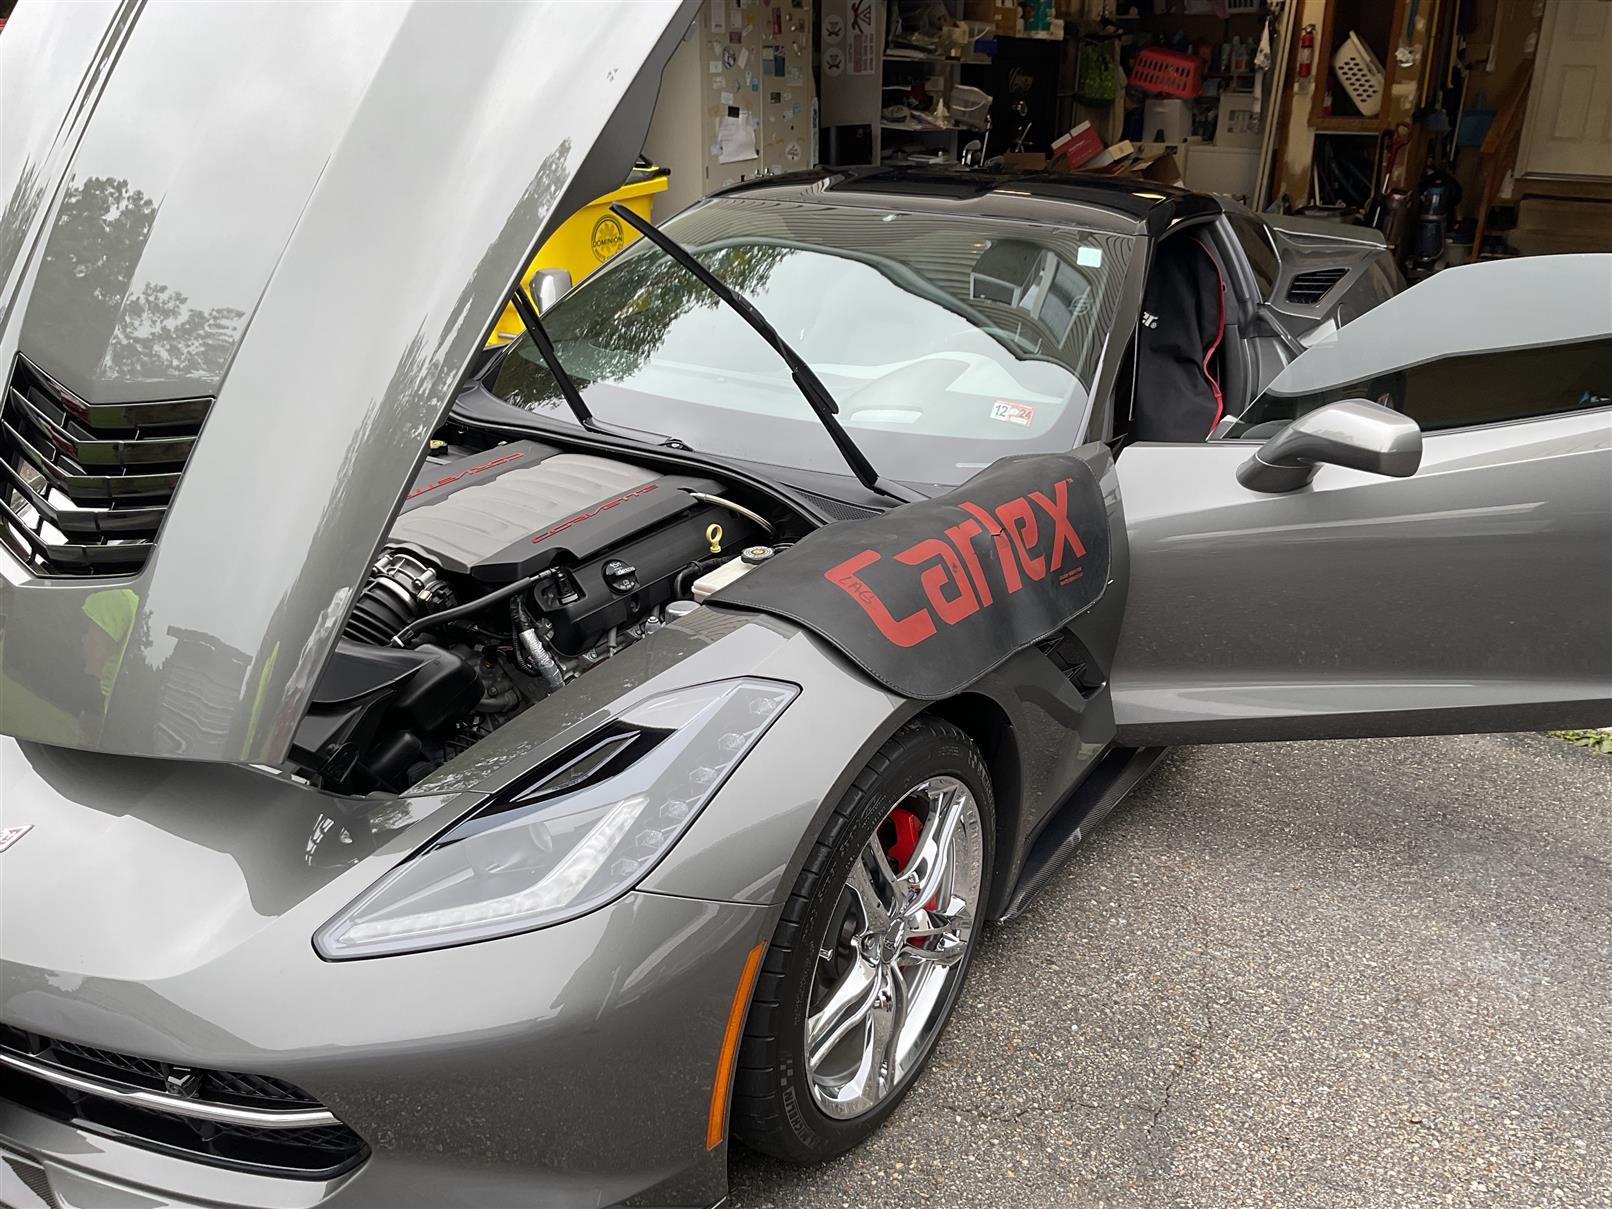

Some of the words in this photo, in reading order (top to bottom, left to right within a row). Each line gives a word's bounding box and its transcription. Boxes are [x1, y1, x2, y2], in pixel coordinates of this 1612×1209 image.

[593, 235, 622, 248] DOMINION
[995, 404, 1008, 417] 12
[1017, 408, 1033, 420] 24
[531, 484, 658, 544] CORVETTE
[824, 480, 1086, 647] Carlex
